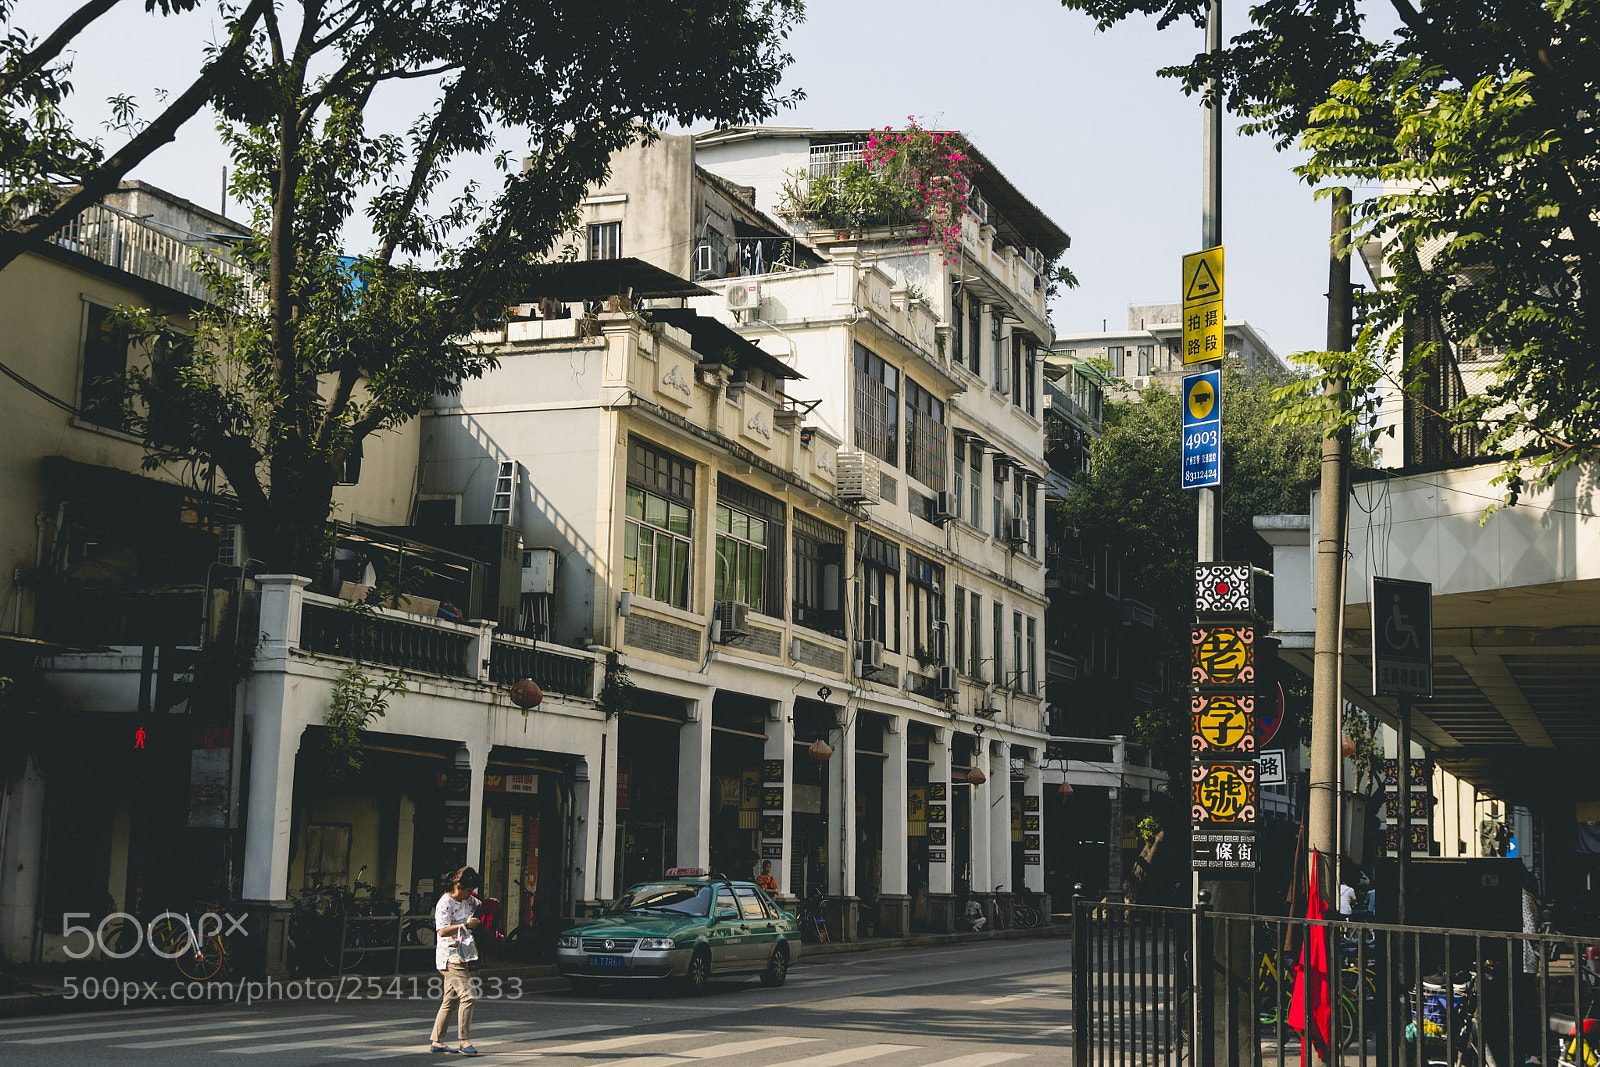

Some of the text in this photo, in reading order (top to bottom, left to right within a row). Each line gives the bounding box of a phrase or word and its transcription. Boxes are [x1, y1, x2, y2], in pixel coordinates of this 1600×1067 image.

[1188, 309, 1218, 332] 拍摄
[1187, 334, 1218, 356] 路段
[1185, 430, 1217, 450] 4903
[1185, 468, 1217, 482] 83112424
[1195, 842, 1252, 861] 一條街
